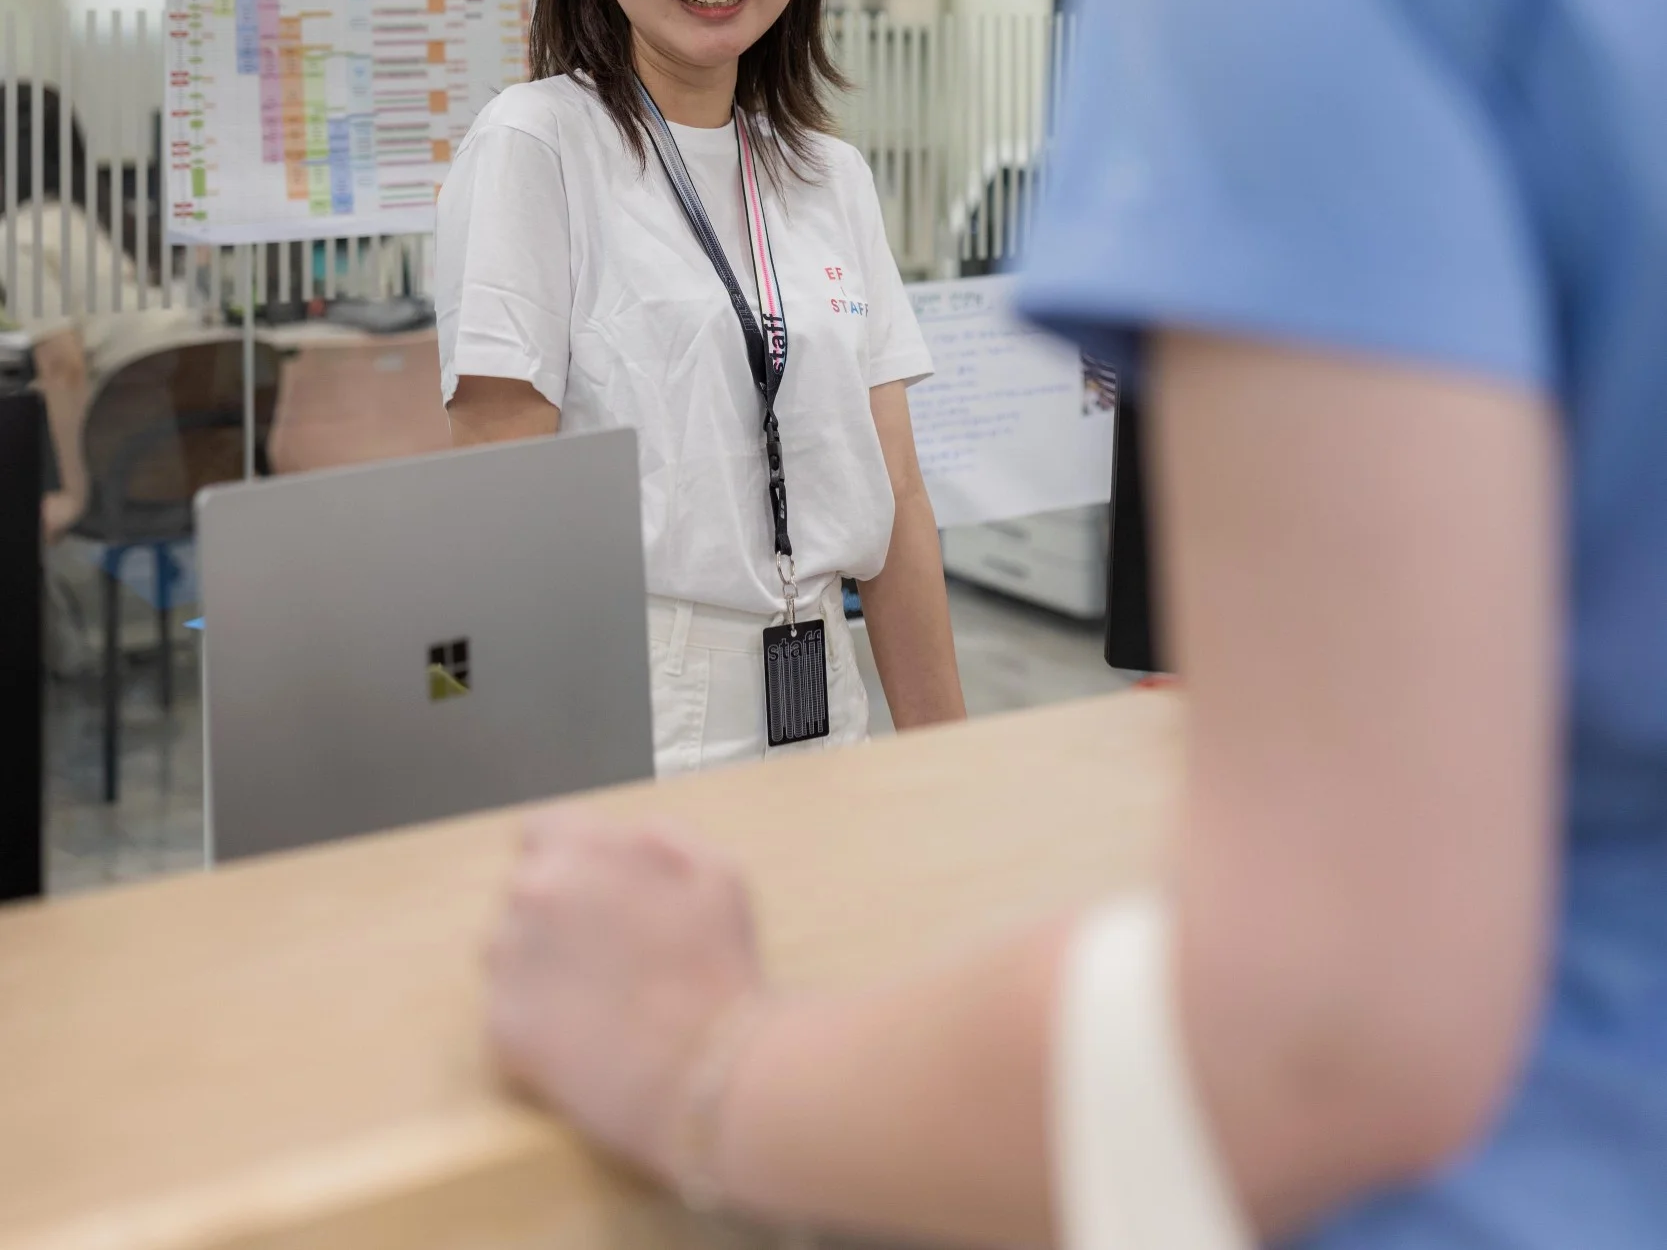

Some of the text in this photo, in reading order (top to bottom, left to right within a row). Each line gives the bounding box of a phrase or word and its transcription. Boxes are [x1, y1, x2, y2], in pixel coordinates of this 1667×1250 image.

[824, 267, 843, 280] EF
[830, 299, 869, 318] STAFF
[762, 313, 787, 374] staff
[768, 629, 822, 662] staff
